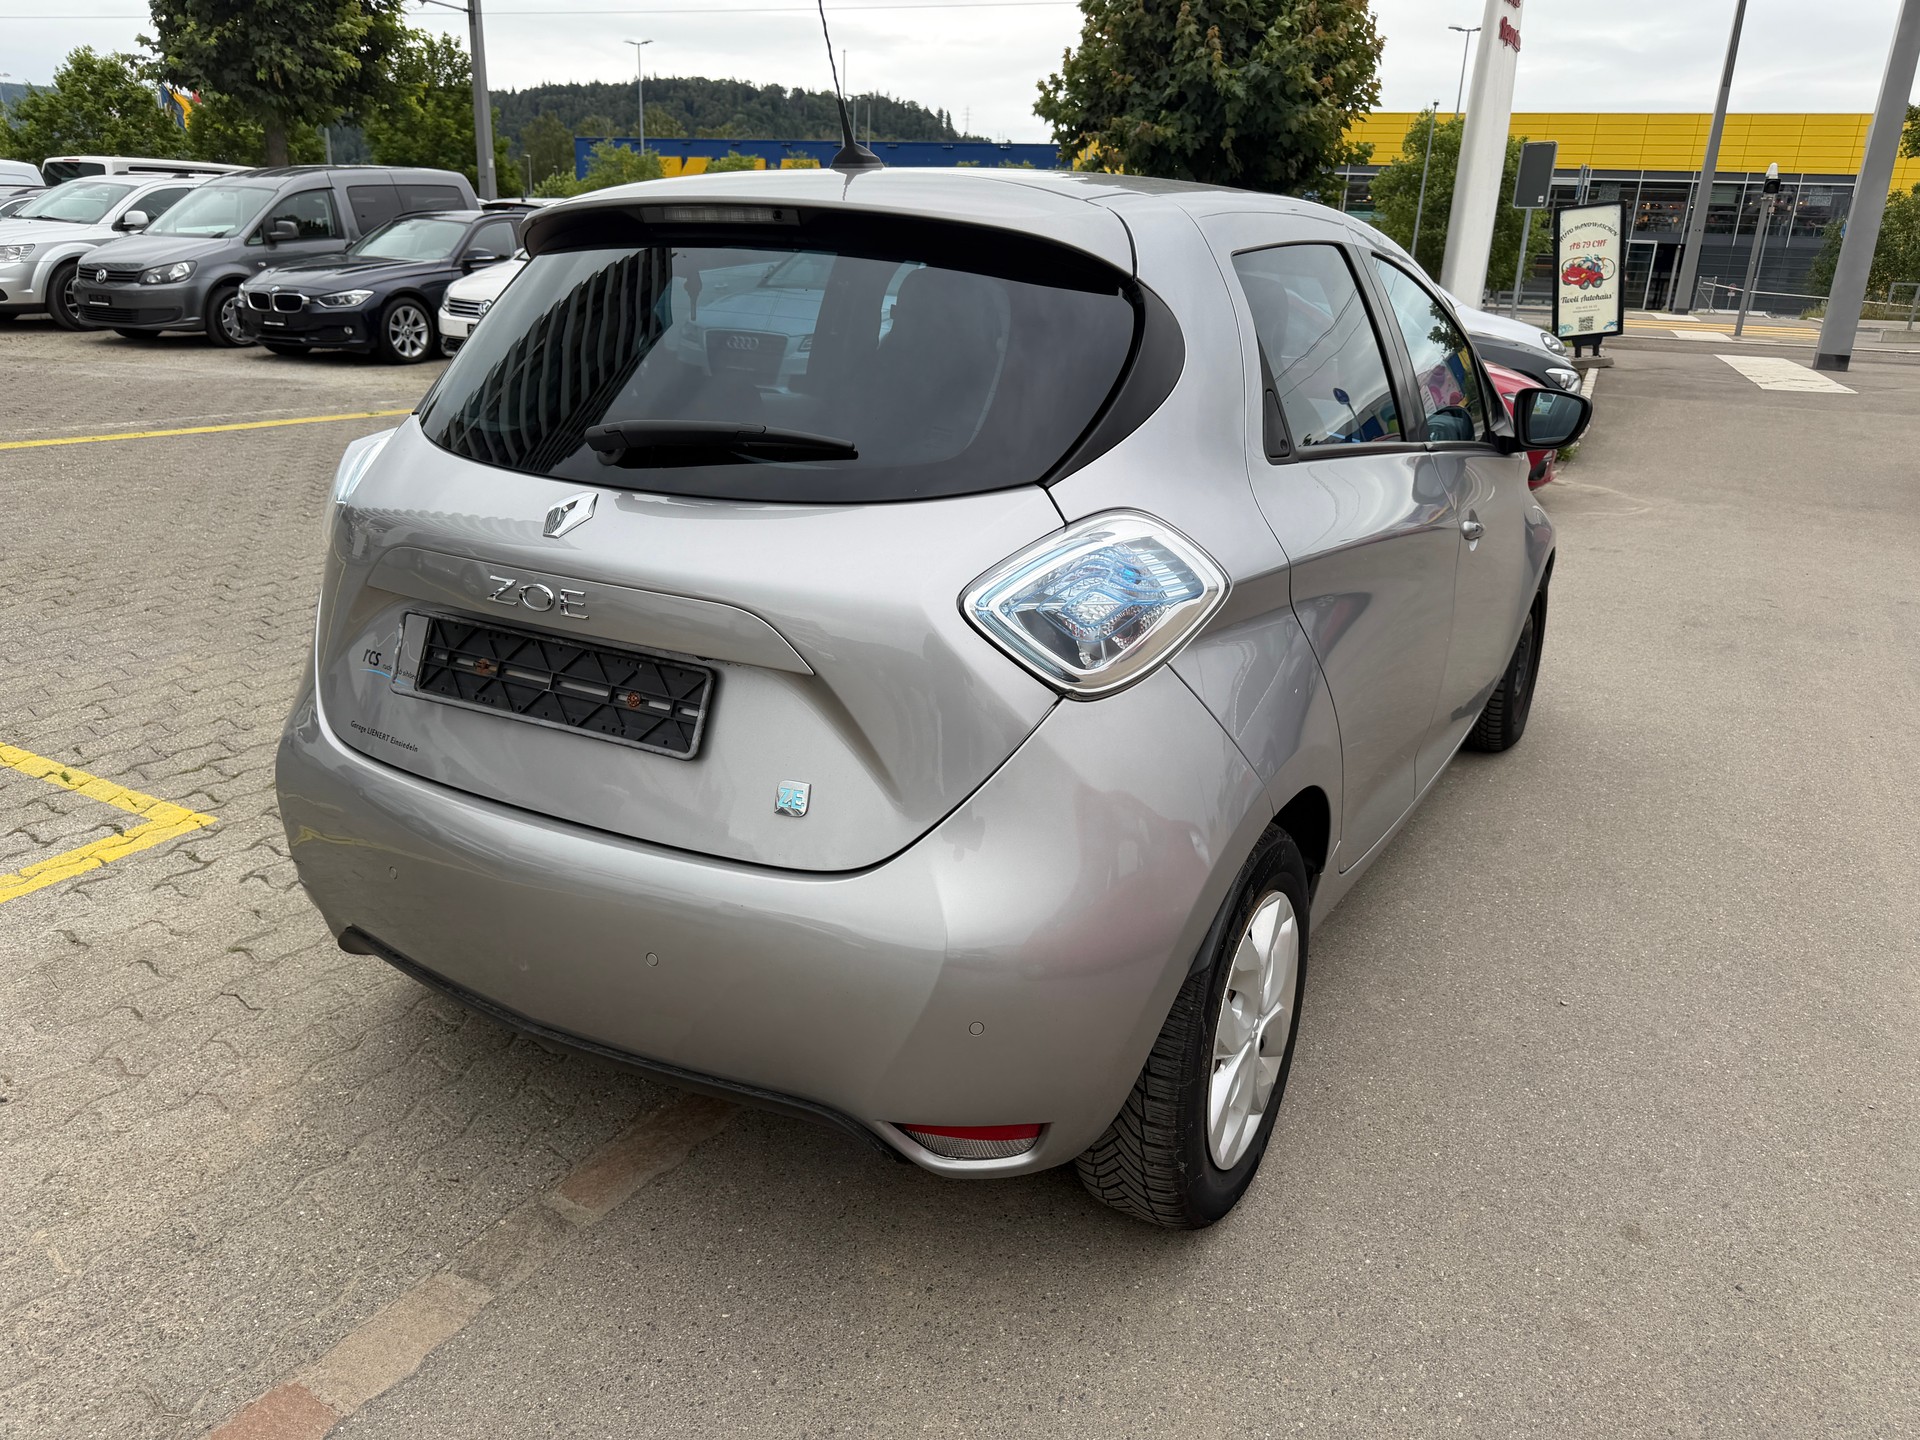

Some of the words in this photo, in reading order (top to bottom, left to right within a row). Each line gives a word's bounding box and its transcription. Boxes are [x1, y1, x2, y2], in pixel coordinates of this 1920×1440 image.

[1569, 241, 1581, 251] AB
[1582, 240, 1591, 249] 79
[1592, 238, 1608, 248] CHF
[1560, 295, 1579, 304] Tivoli
[487, 575, 590, 620] ZOE
[362, 648, 382, 666] rcs
[350, 720, 367, 734] Garage
[367, 727, 390, 742] LIENERT
[390, 737, 418, 753] Einsiedeln
